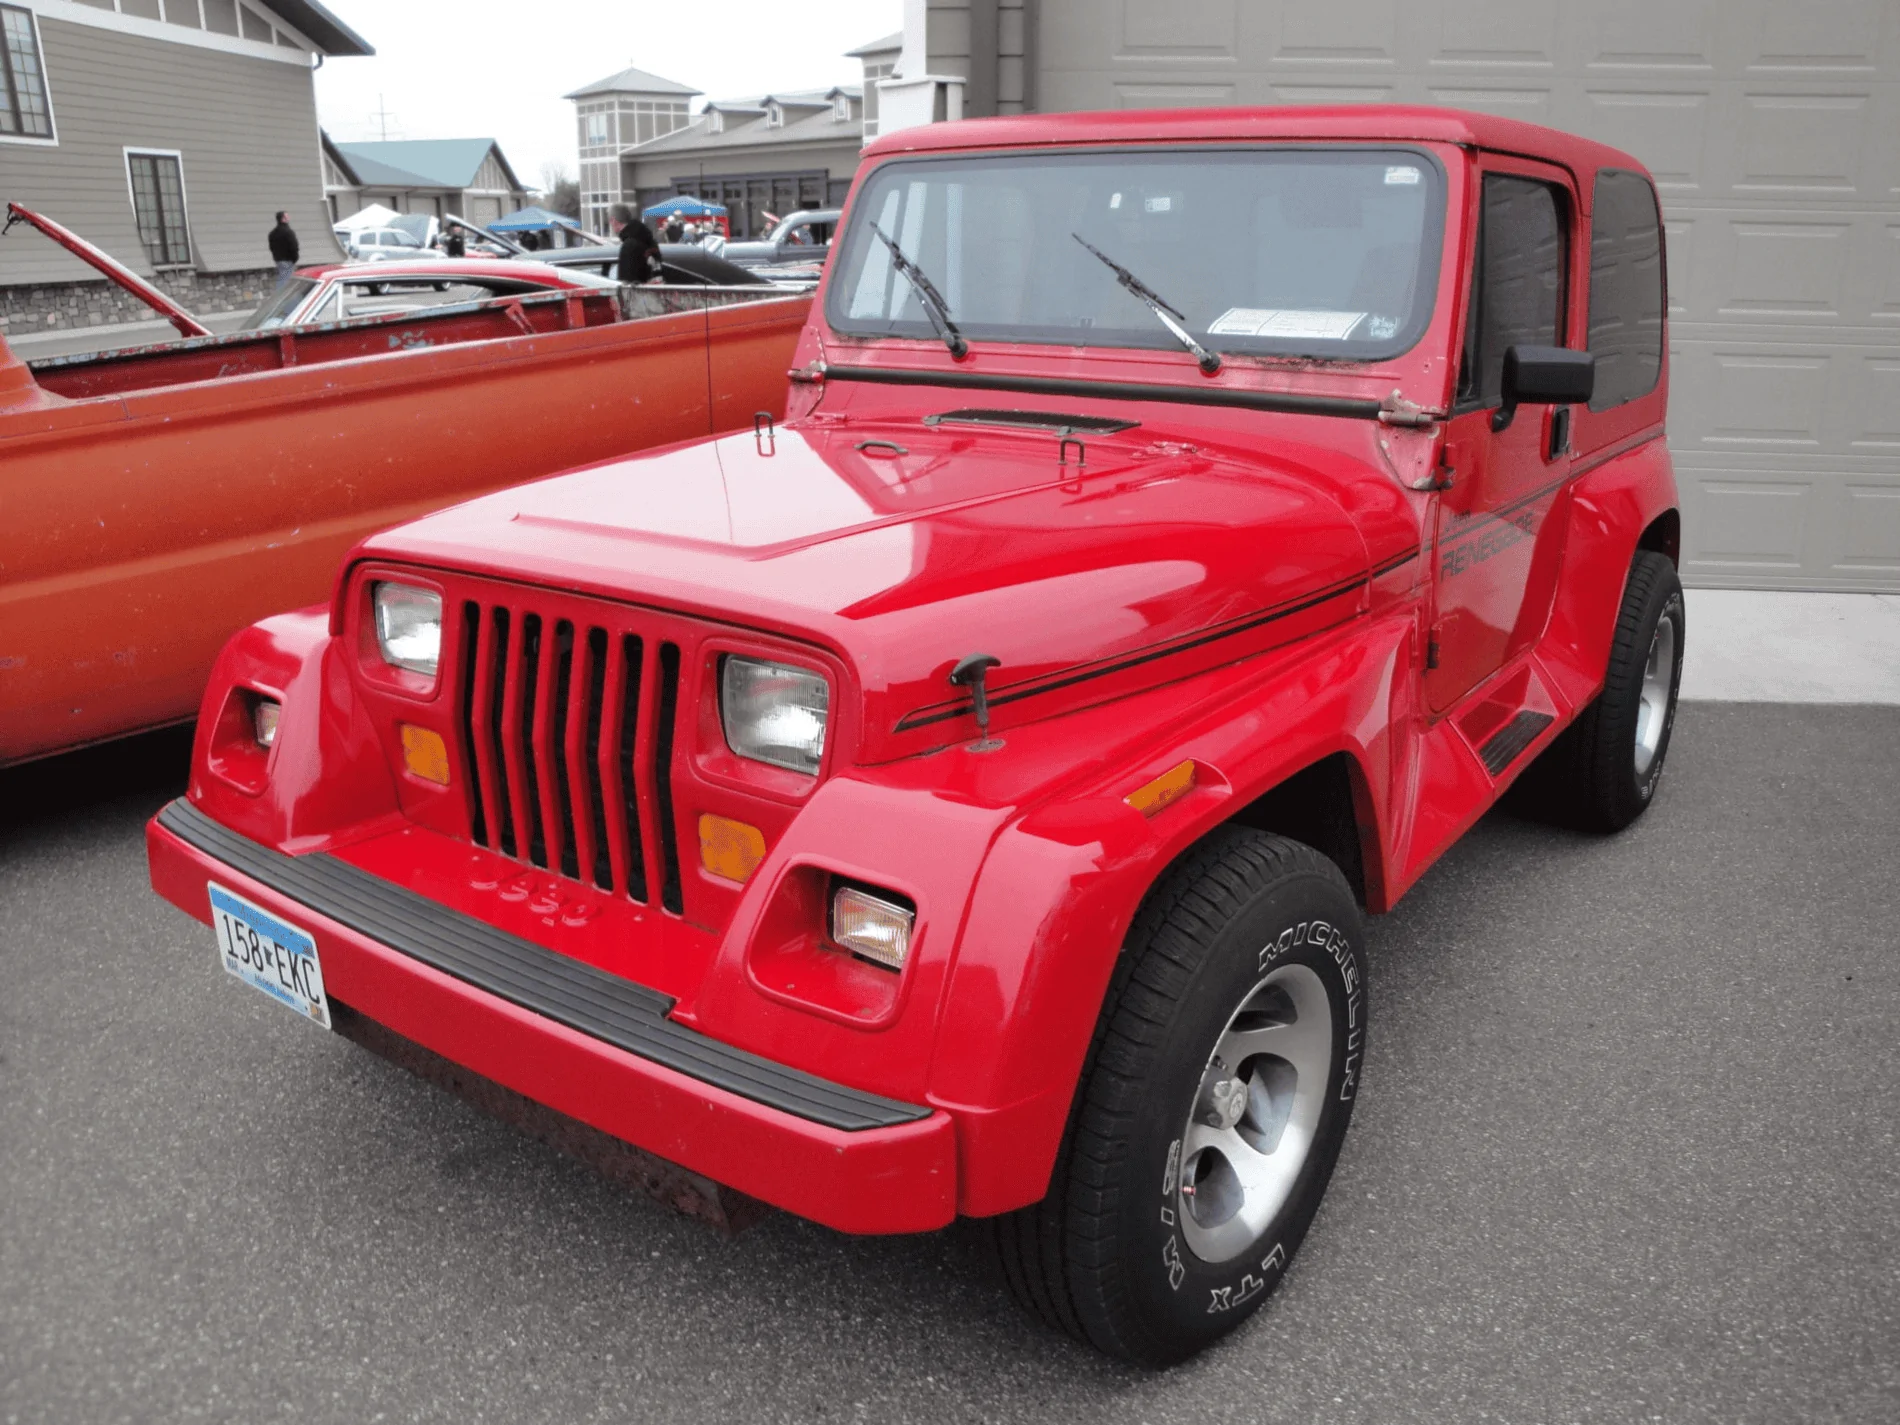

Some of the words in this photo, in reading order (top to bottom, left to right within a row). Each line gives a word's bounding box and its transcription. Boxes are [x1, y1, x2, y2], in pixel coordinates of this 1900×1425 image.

[223, 914, 264, 972] 158
[273, 942, 321, 1005] EKC
[1258, 920, 1361, 1101] MICHELIN
[1207, 1243, 1287, 1314] LTX
